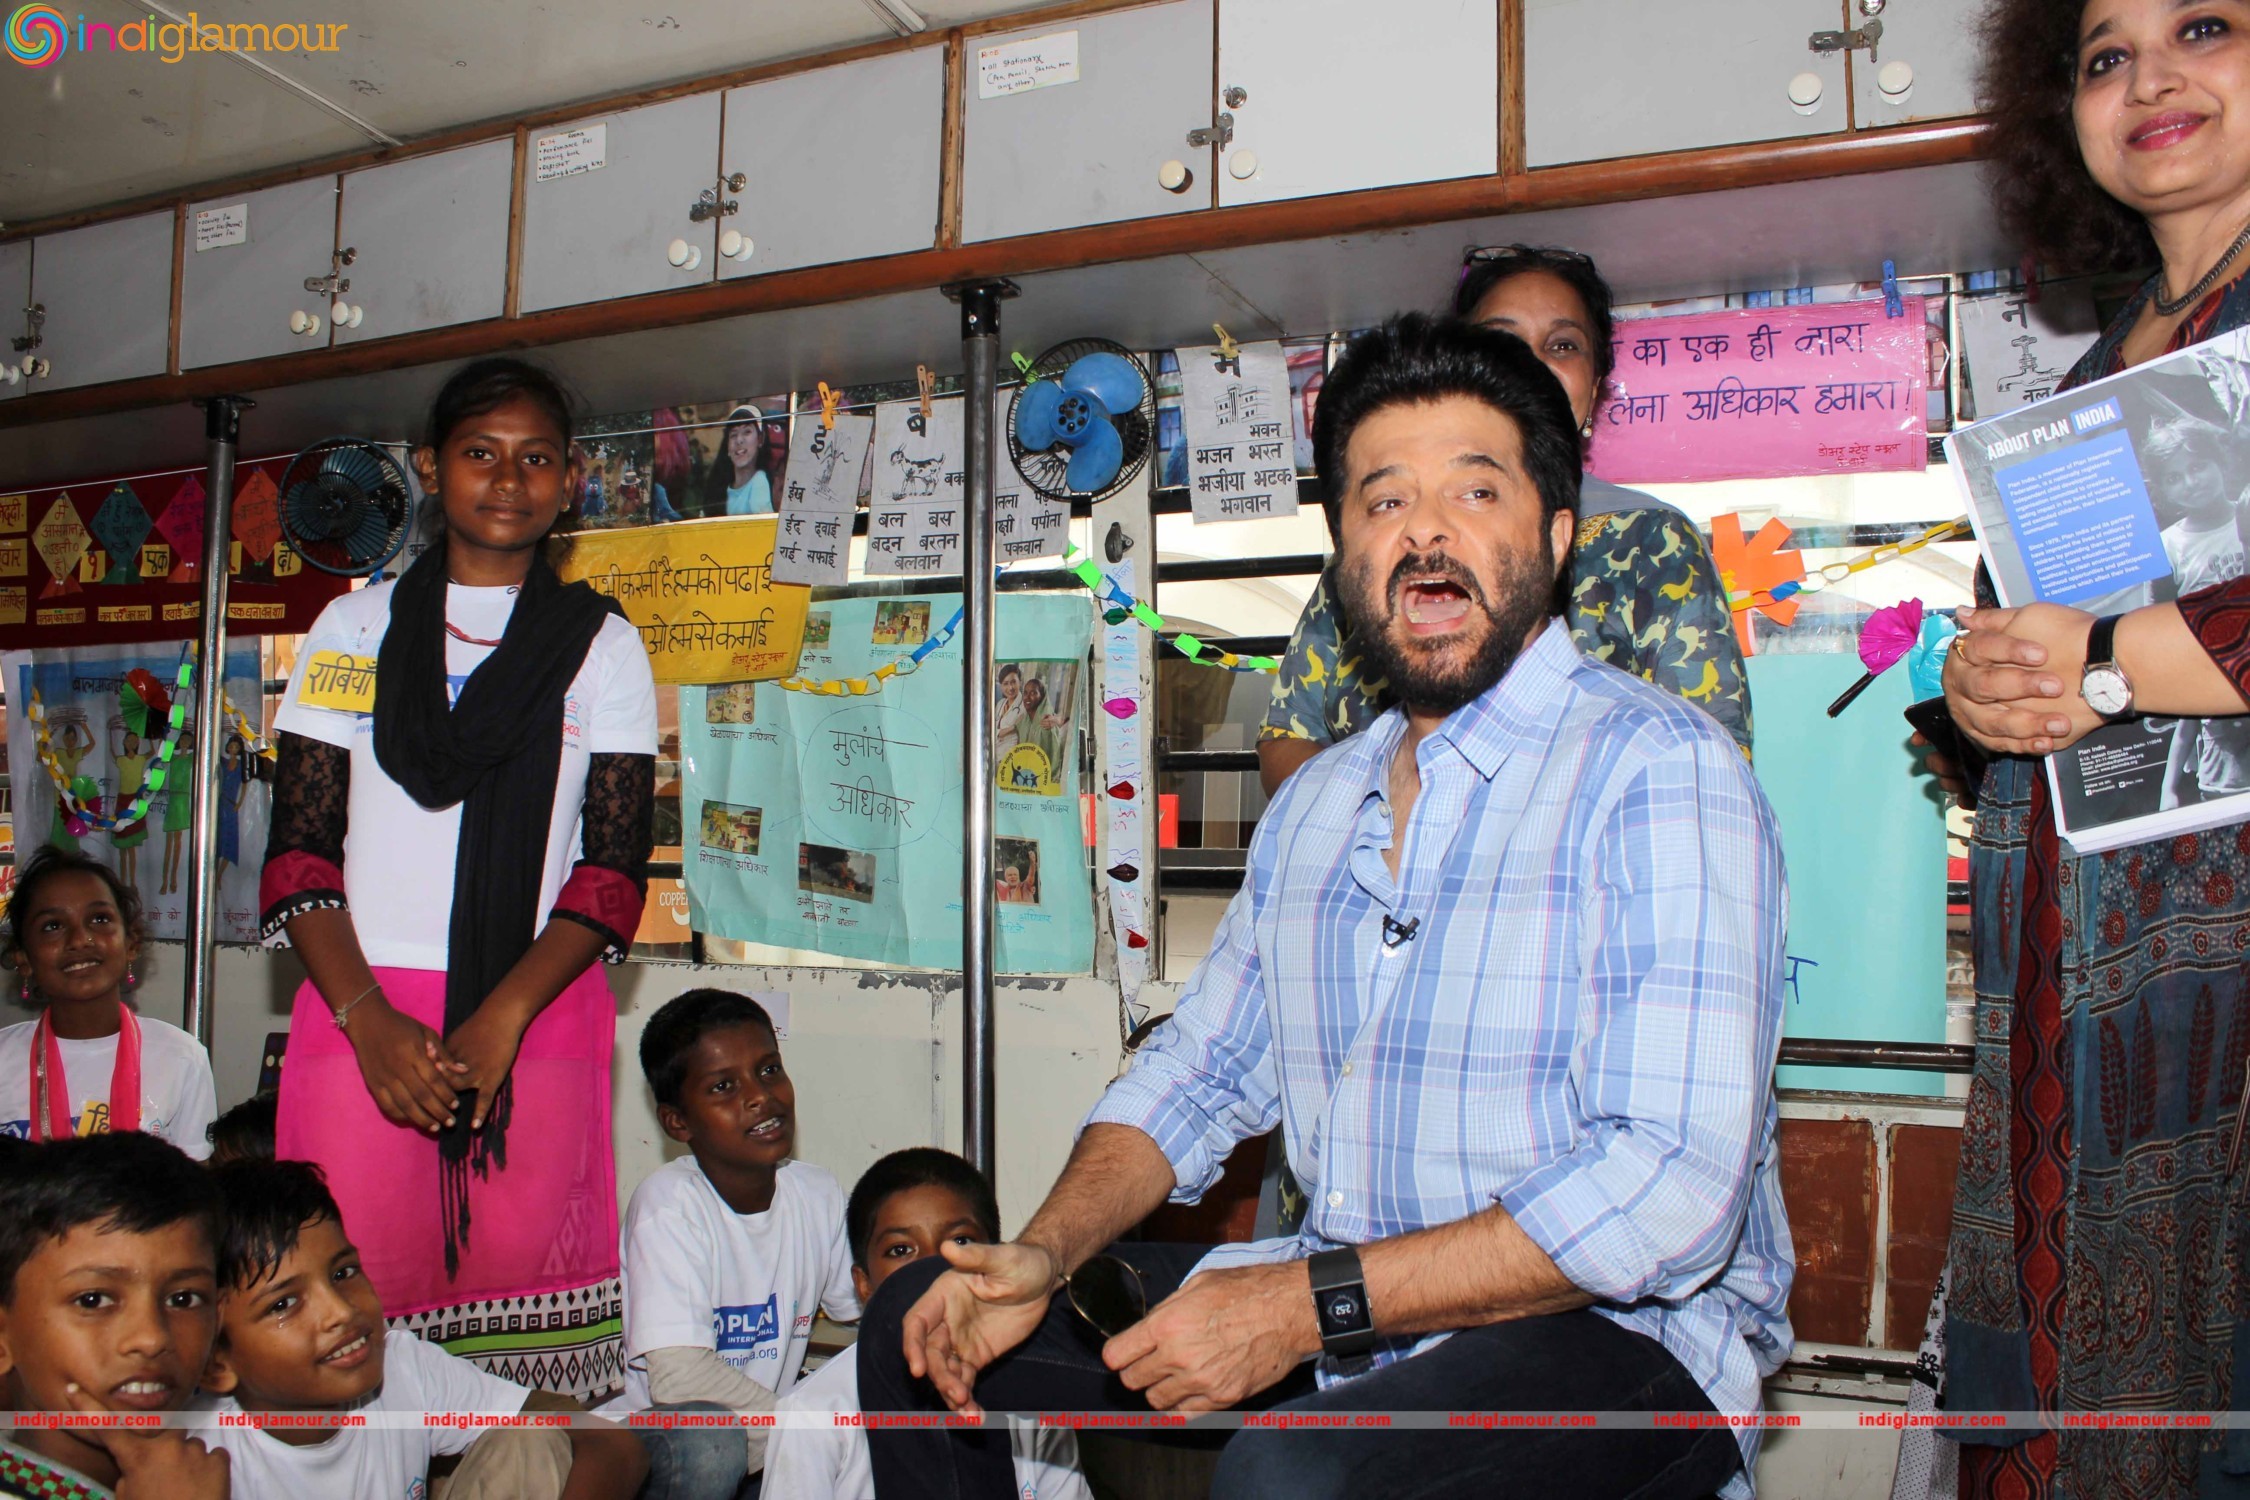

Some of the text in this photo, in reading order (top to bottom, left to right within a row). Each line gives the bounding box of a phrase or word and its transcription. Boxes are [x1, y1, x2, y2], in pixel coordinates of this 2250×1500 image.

[1633, 338, 1671, 366] का
[1680, 335, 1729, 362] एक
[1747, 324, 1781, 361] ही
[1795, 323, 1870, 355] नारा
[1682, 376, 1805, 421] अधिकार
[1250, 423, 1282, 438] भवन
[1987, 403, 2117, 461] ABOUT PLAN INDIA
[1197, 442, 1284, 464] भजन भरत
[1199, 467, 1293, 492] भजीया भटक
[1221, 494, 1273, 514] भगवान
[785, 514, 841, 538] ईद दवाई
[878, 510, 956, 528] बल बस
[1031, 510, 1062, 531] पपीता
[871, 533, 960, 553] बदन बरतन
[1003, 539, 1045, 556] पकवान
[780, 542, 837, 568] राई सफाई
[894, 554, 943, 570] बलवान
[716, 607, 775, 650] कमाई
[2091, 744, 2106, 752] India
[829, 775, 915, 829] अधिकार
[735, 856, 769, 876] अधिकार
